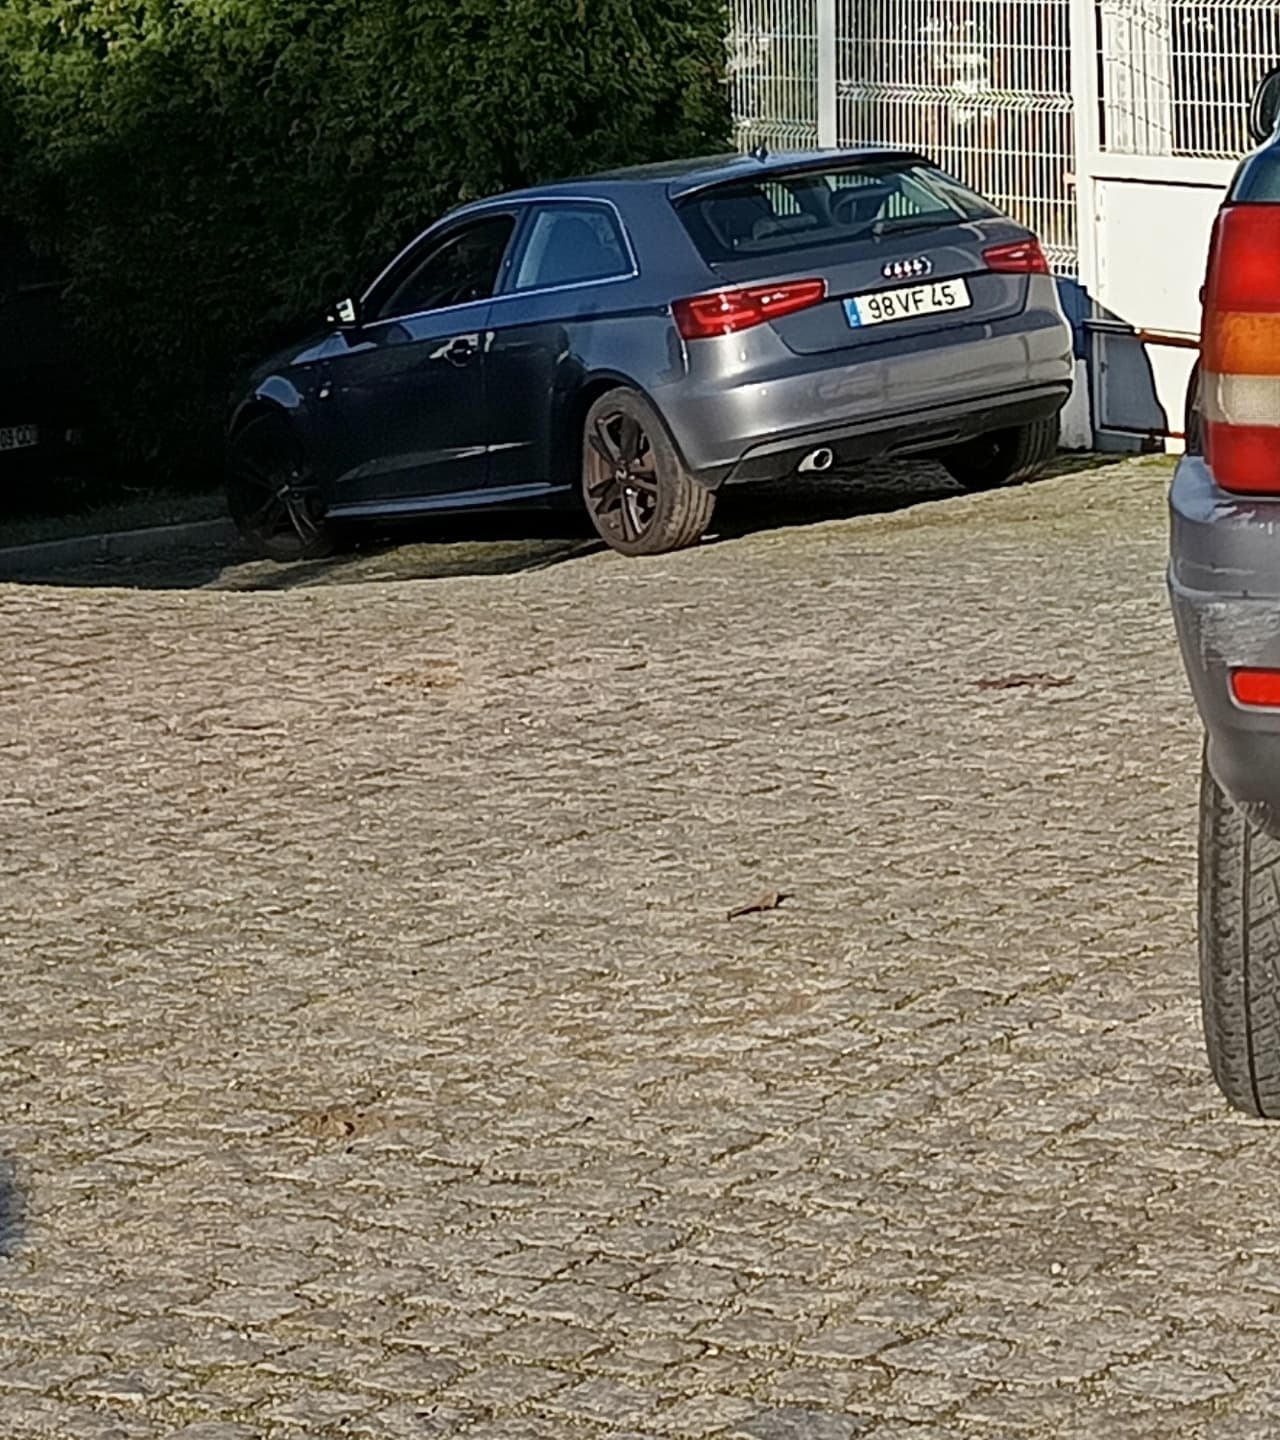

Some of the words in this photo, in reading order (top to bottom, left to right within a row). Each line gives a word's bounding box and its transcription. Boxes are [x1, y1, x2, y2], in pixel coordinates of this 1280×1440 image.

[867, 297, 895, 320] 98
[896, 288, 924, 312] VF
[931, 284, 955, 307] 45
